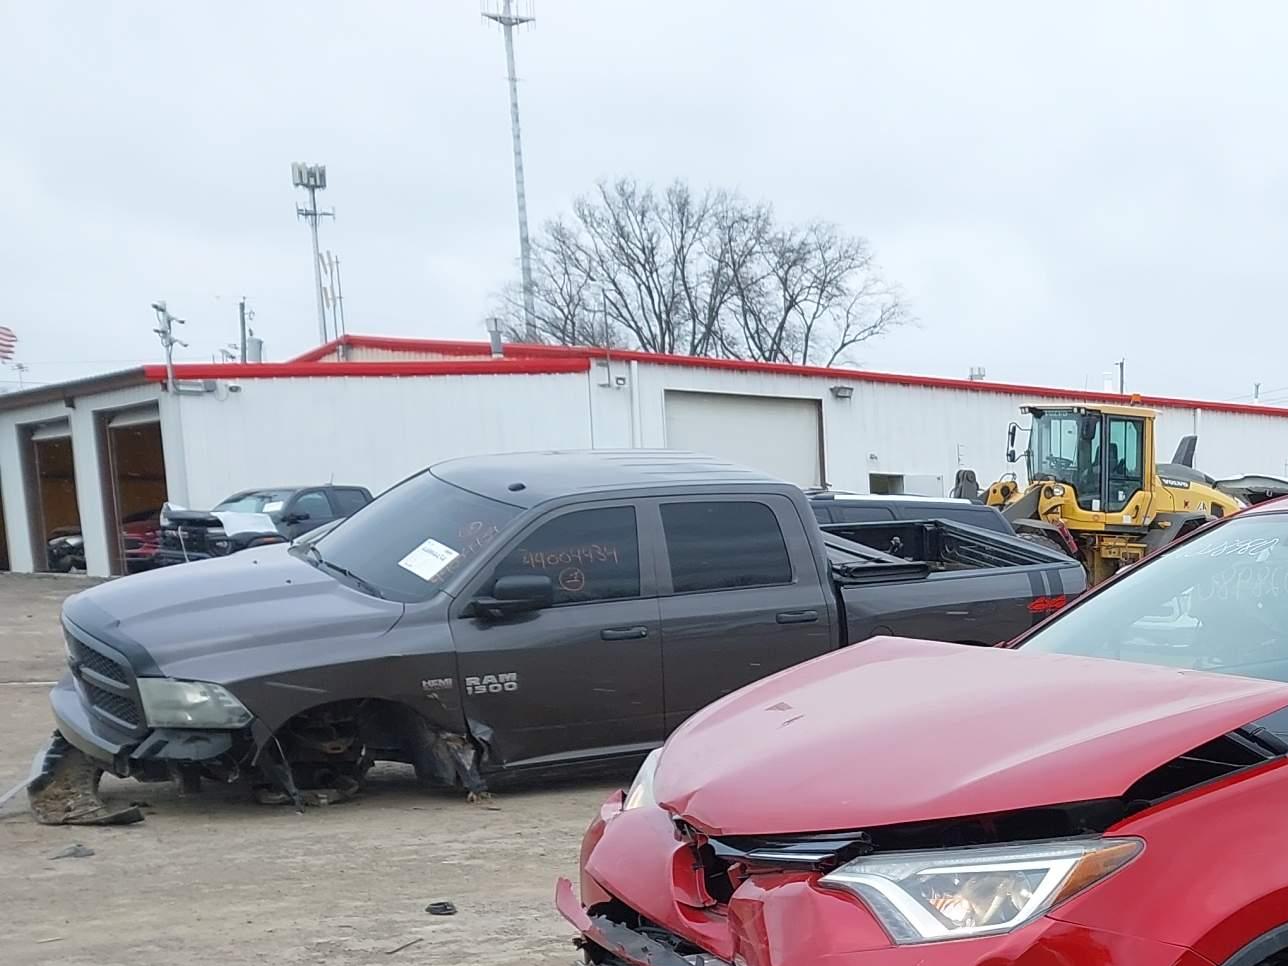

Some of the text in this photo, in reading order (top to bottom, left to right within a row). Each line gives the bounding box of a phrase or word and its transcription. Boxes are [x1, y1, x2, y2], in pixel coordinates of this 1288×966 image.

[1162, 478, 1189, 488] VOLVO
[465, 672, 517, 686] RAM
[466, 681, 518, 696] 1500
